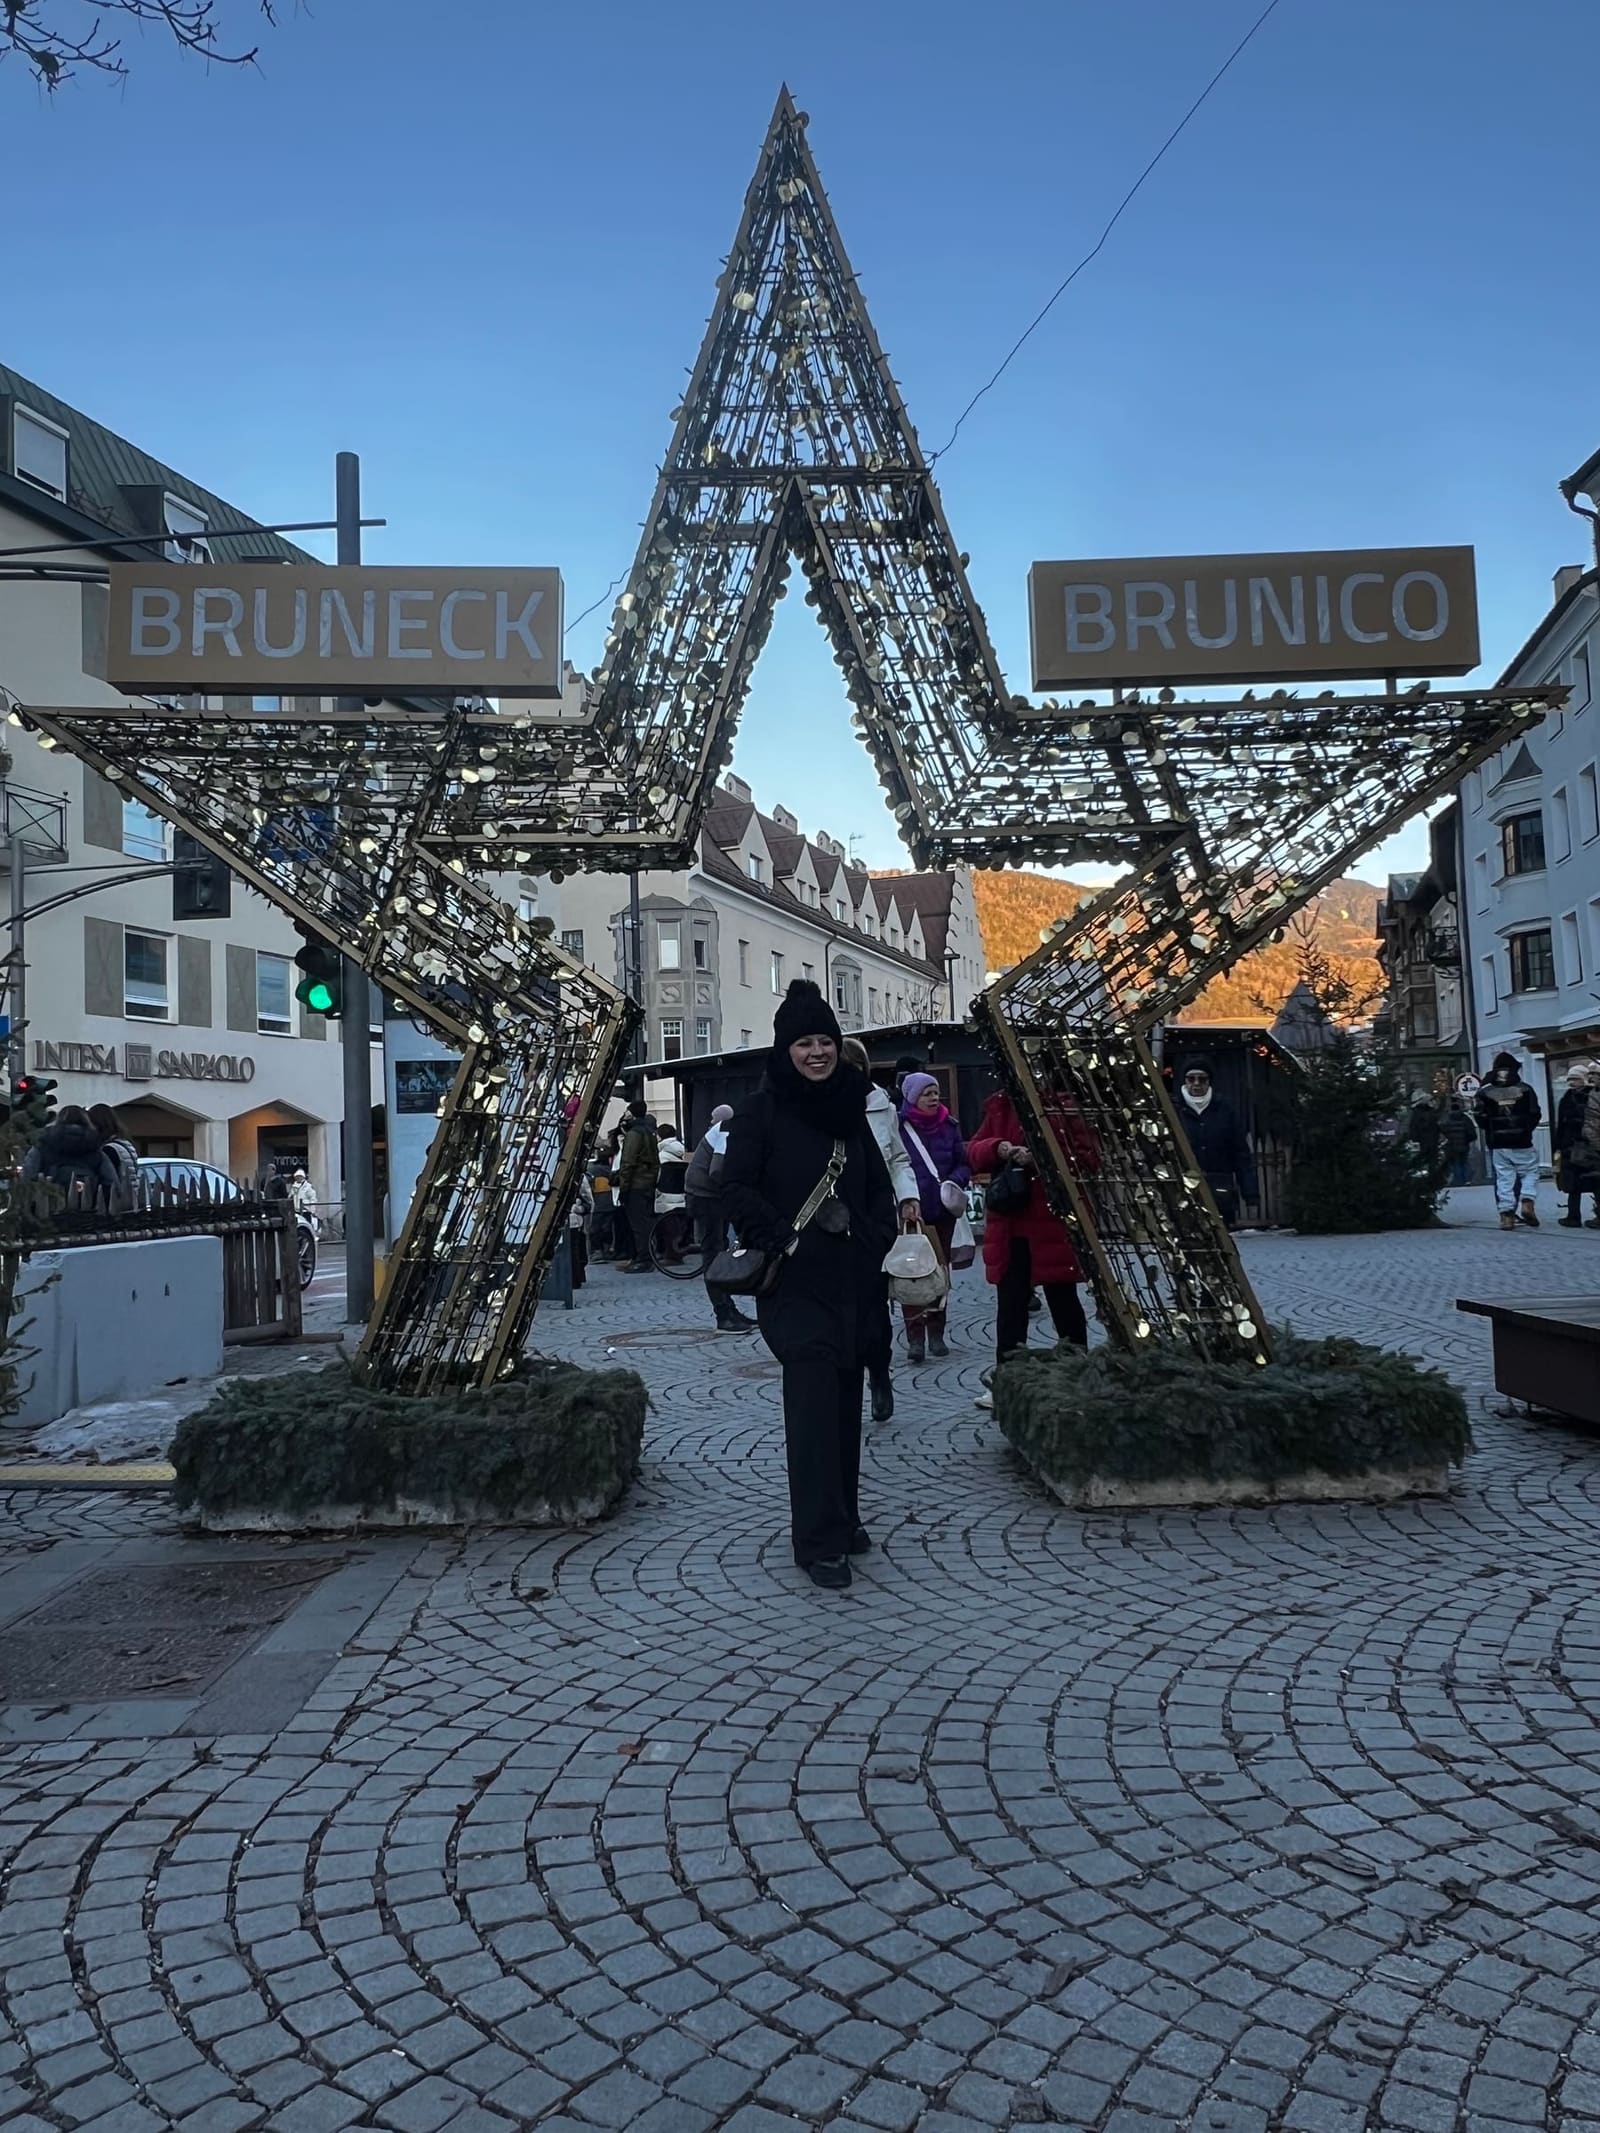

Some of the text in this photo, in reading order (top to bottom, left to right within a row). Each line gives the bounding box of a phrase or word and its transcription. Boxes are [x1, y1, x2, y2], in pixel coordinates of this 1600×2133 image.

[130, 586, 545, 660] BRUNECK
[1063, 570, 1450, 653] BRUNICO
[33, 1040, 255, 1082] INTESA SANPAOLO
